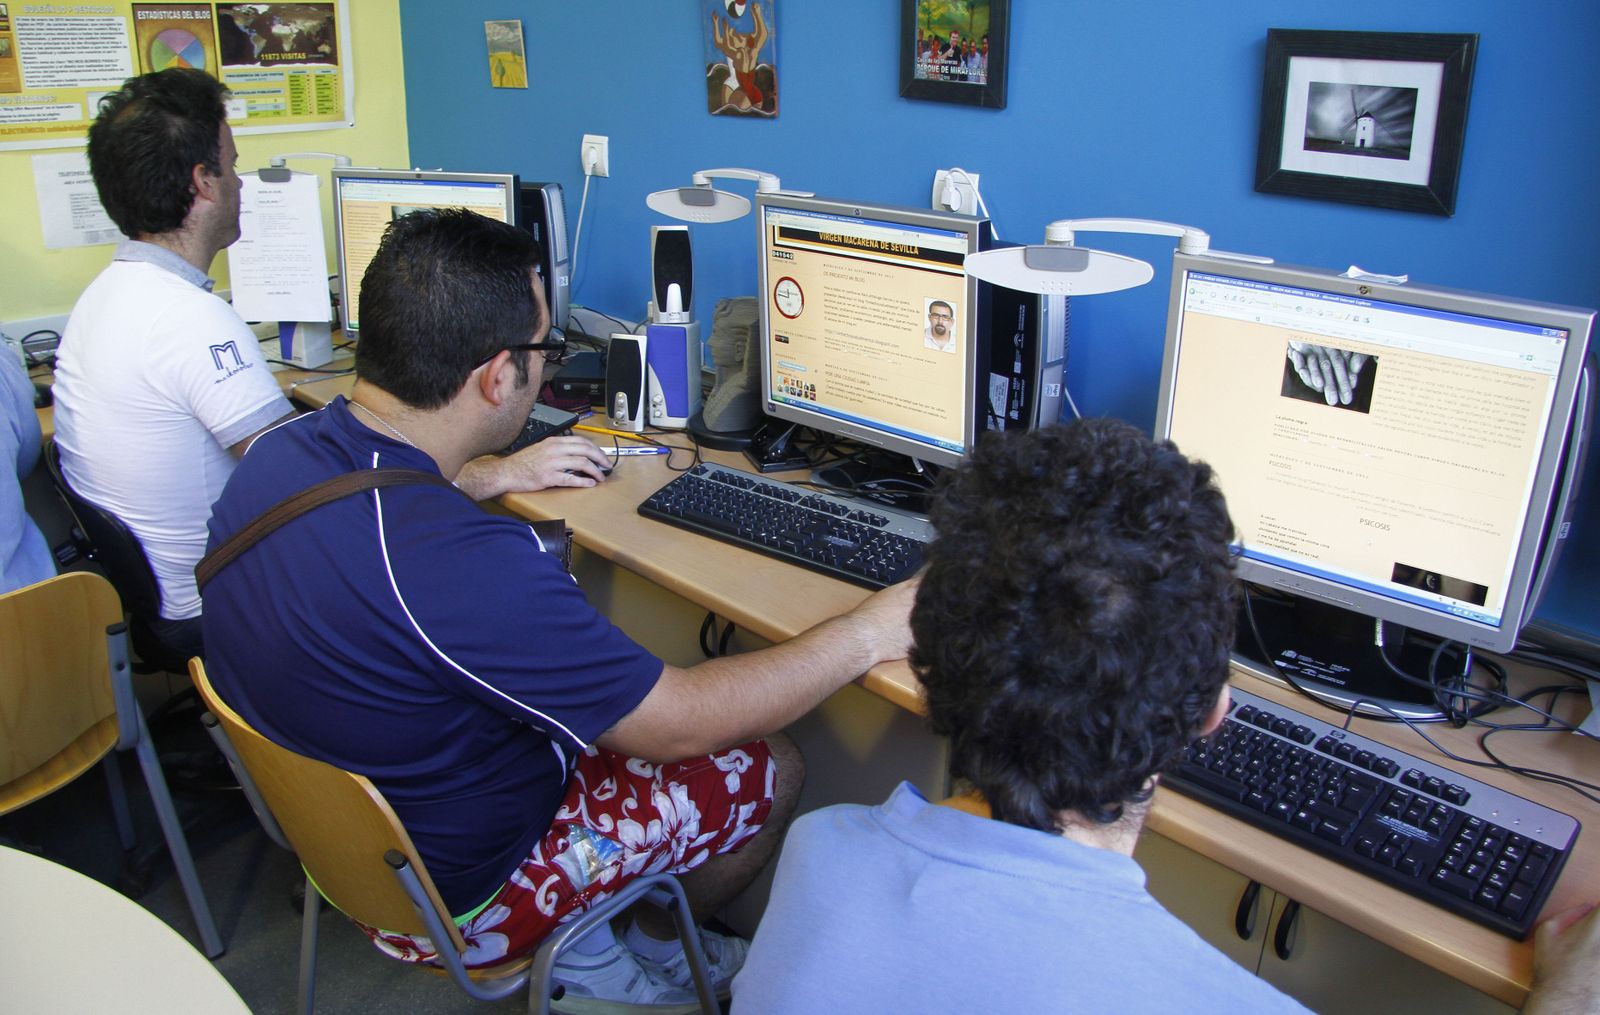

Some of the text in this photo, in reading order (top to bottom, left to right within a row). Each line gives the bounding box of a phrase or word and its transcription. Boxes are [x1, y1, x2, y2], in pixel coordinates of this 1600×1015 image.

[182, 10, 194, 19] DEL
[194, 10, 211, 19] BLOG
[280, 52, 306, 60] VISITAS
[916, 62, 939, 73] PARQUE
[940, 65, 949, 74] DE
[819, 232, 919, 255] VIRGEN MACARENA DE SEVILLA
[1360, 518, 1391, 531] PSICOSIS
